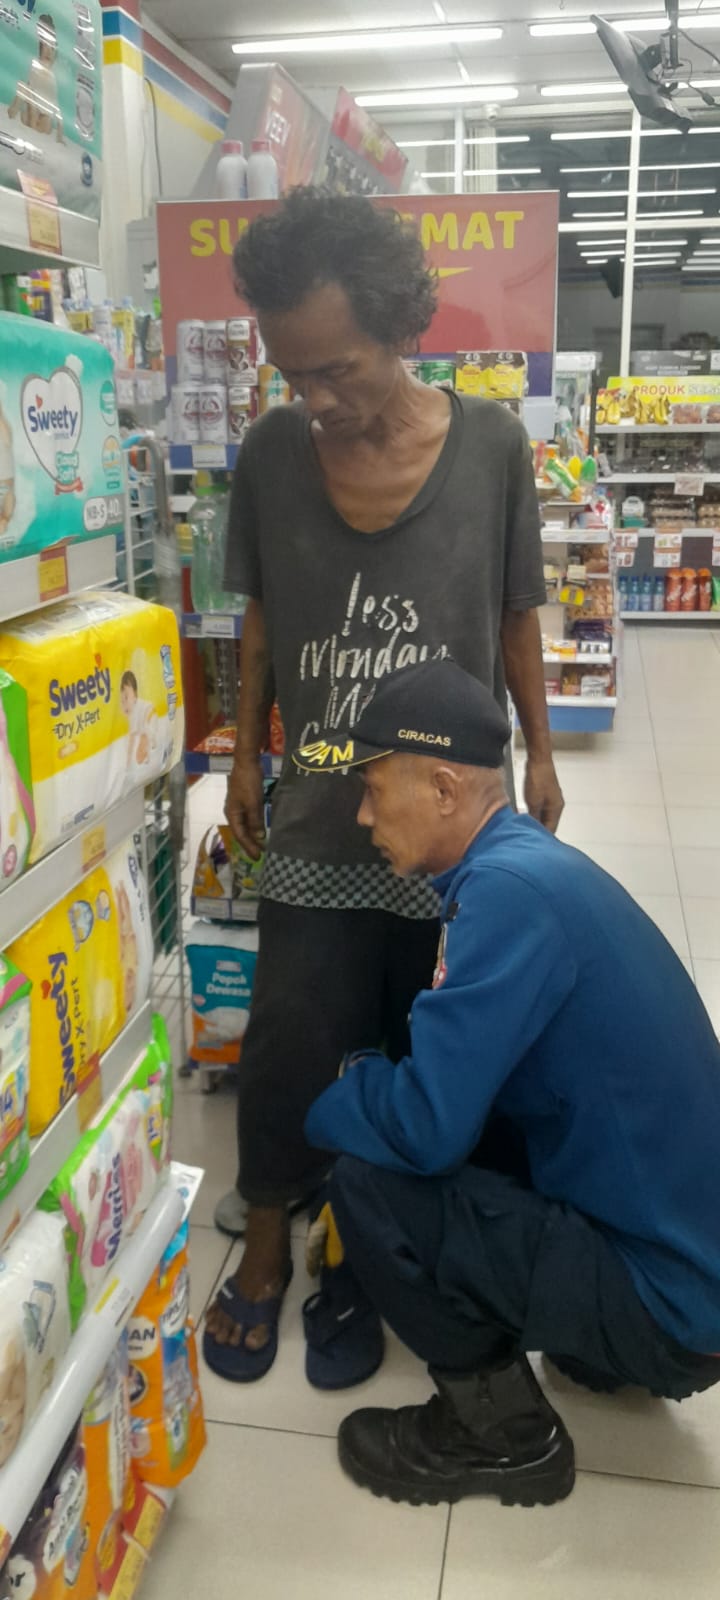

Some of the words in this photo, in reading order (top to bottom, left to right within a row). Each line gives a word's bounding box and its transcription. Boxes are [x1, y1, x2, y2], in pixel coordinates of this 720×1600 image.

[633, 384, 685, 396] PRODUK
[27, 405, 78, 437] Sweety
[49, 666, 111, 717] Sweety
[55, 722, 74, 740] Dry
[397, 729, 452, 748] CIRACAS
[107, 1152, 122, 1261] Merries
